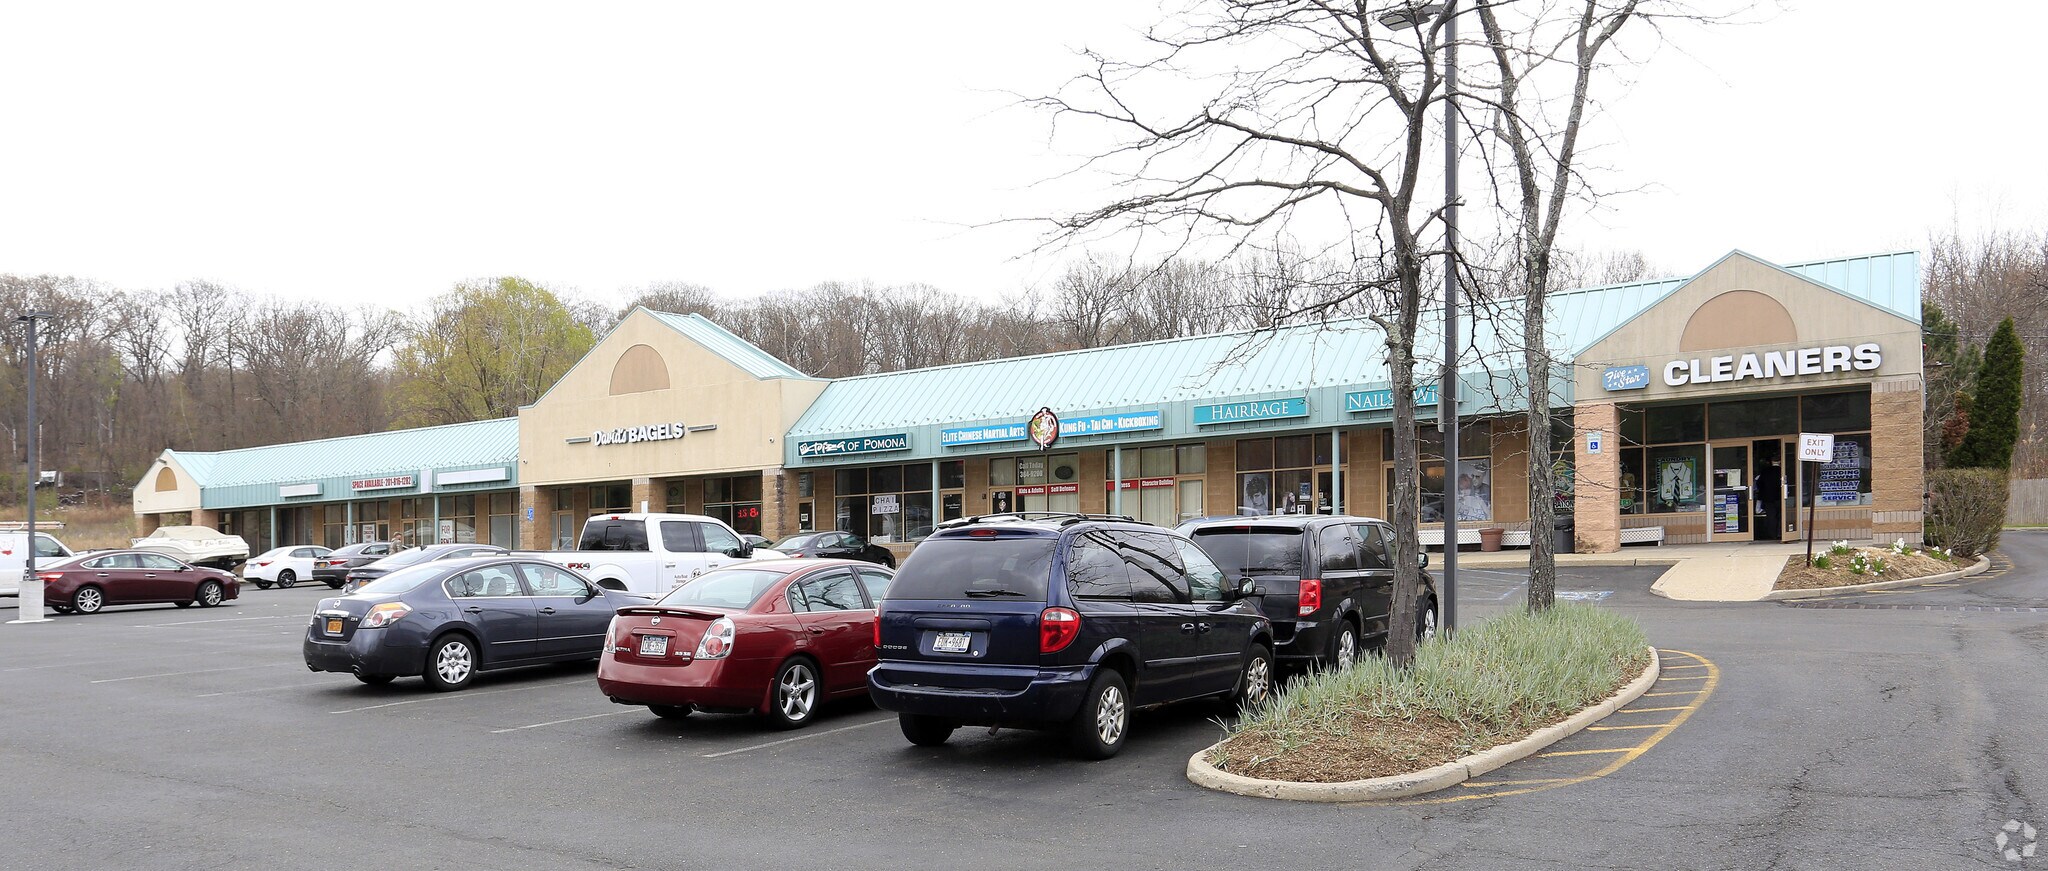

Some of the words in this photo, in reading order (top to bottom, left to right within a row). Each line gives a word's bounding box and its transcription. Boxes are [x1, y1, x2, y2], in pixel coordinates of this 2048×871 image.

[1663, 343, 1882, 386] CLEANERS
[1605, 370, 1626, 382] Five
[1618, 374, 1640, 388] Star
[1348, 392, 1393, 409] NAILS
[1060, 422, 1077, 433] KUNG
[1078, 420, 1086, 432] FU
[1091, 419, 1101, 431] TAI
[1102, 418, 1113, 430] CHI
[1118, 415, 1159, 429] KICKBOXING
[593, 427, 627, 446] David's
[628, 422, 684, 443] BAGELS
[942, 431, 958, 443] ELITE
[958, 429, 982, 441] CHINESE
[983, 427, 1009, 439] MARTIAL
[1009, 426, 1025, 437] ARTS
[847, 441, 860, 451] OF
[864, 437, 906, 450] POMONA
[1805, 448, 1826, 456] ONLY
[352, 480, 364, 489] SPACE
[364, 478, 383, 488] AVAILABLE
[874, 497, 896, 505] CHAI
[872, 505, 899, 513] PIZZA
[441, 525, 450, 534] FOR
